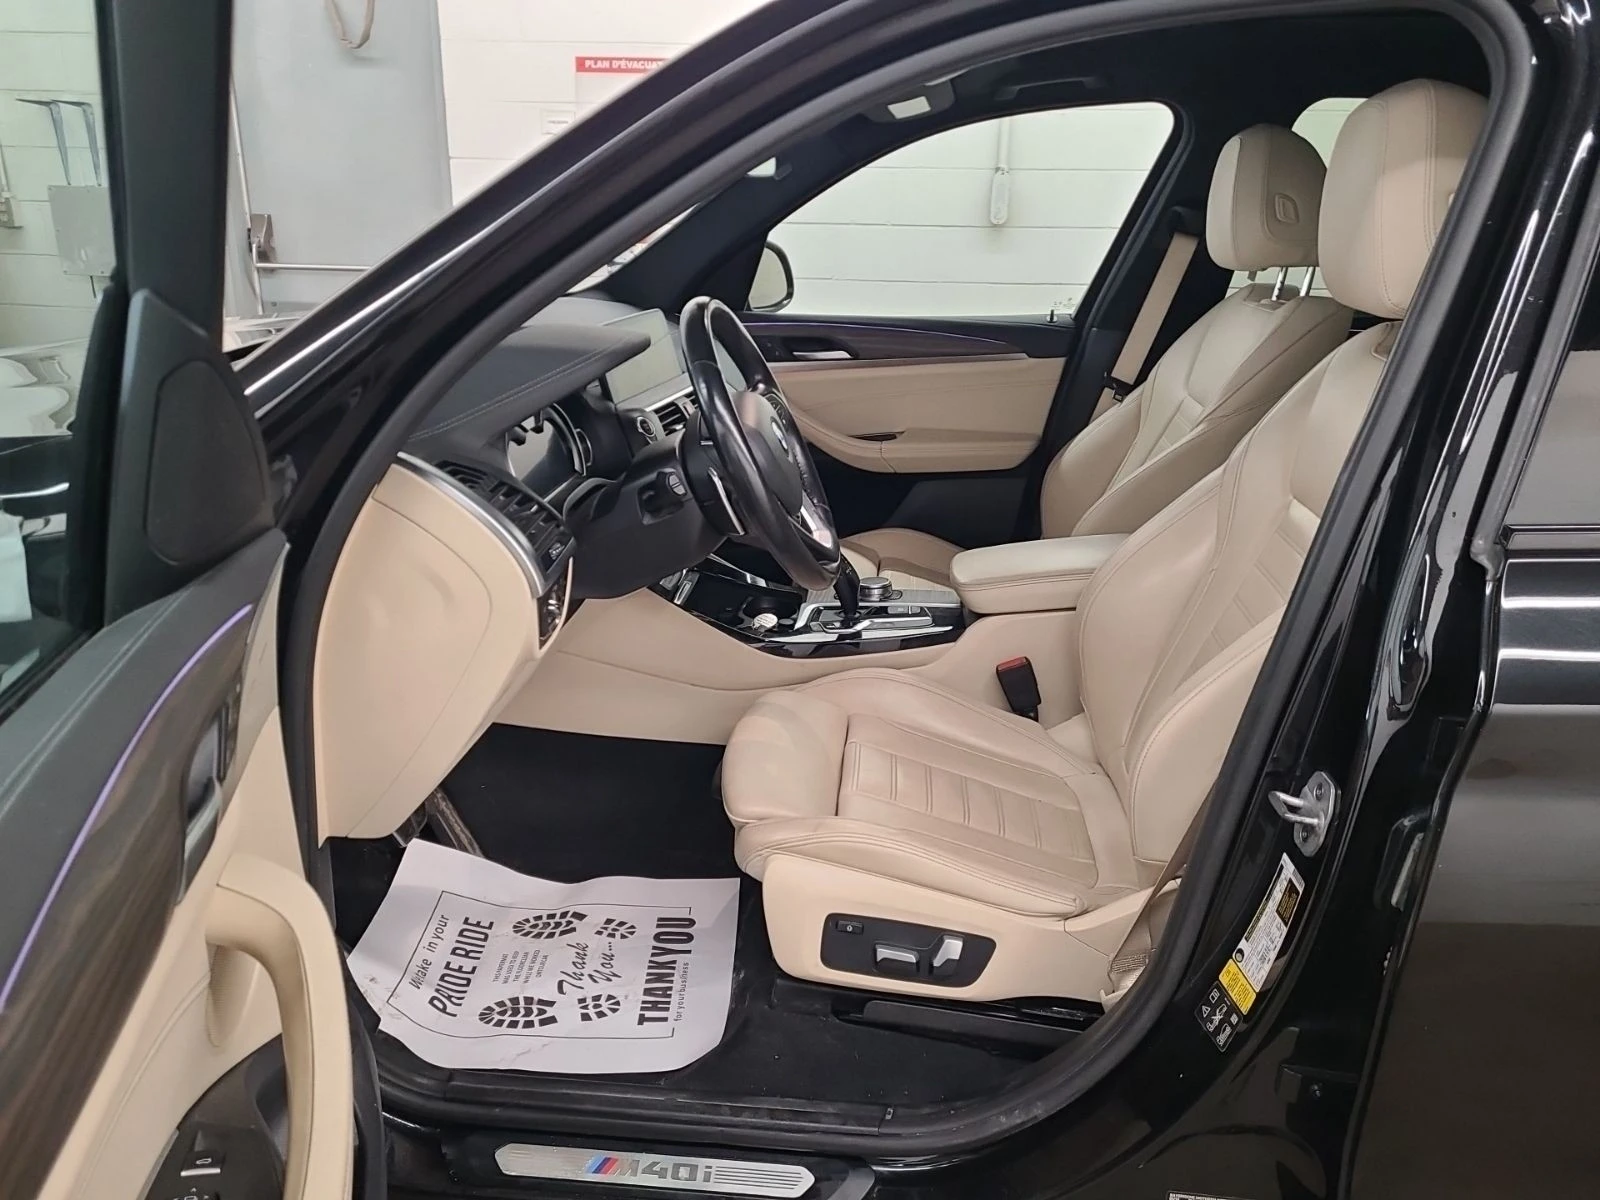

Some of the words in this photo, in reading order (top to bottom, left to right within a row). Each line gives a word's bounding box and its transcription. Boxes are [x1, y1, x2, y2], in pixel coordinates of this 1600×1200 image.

[584, 60, 609, 69] PLAN
[423, 940, 438, 953] in
[431, 914, 449, 941] your
[450, 916, 494, 961] RIDE
[428, 961, 477, 1017] PRIDE
[557, 943, 589, 995] Thank
